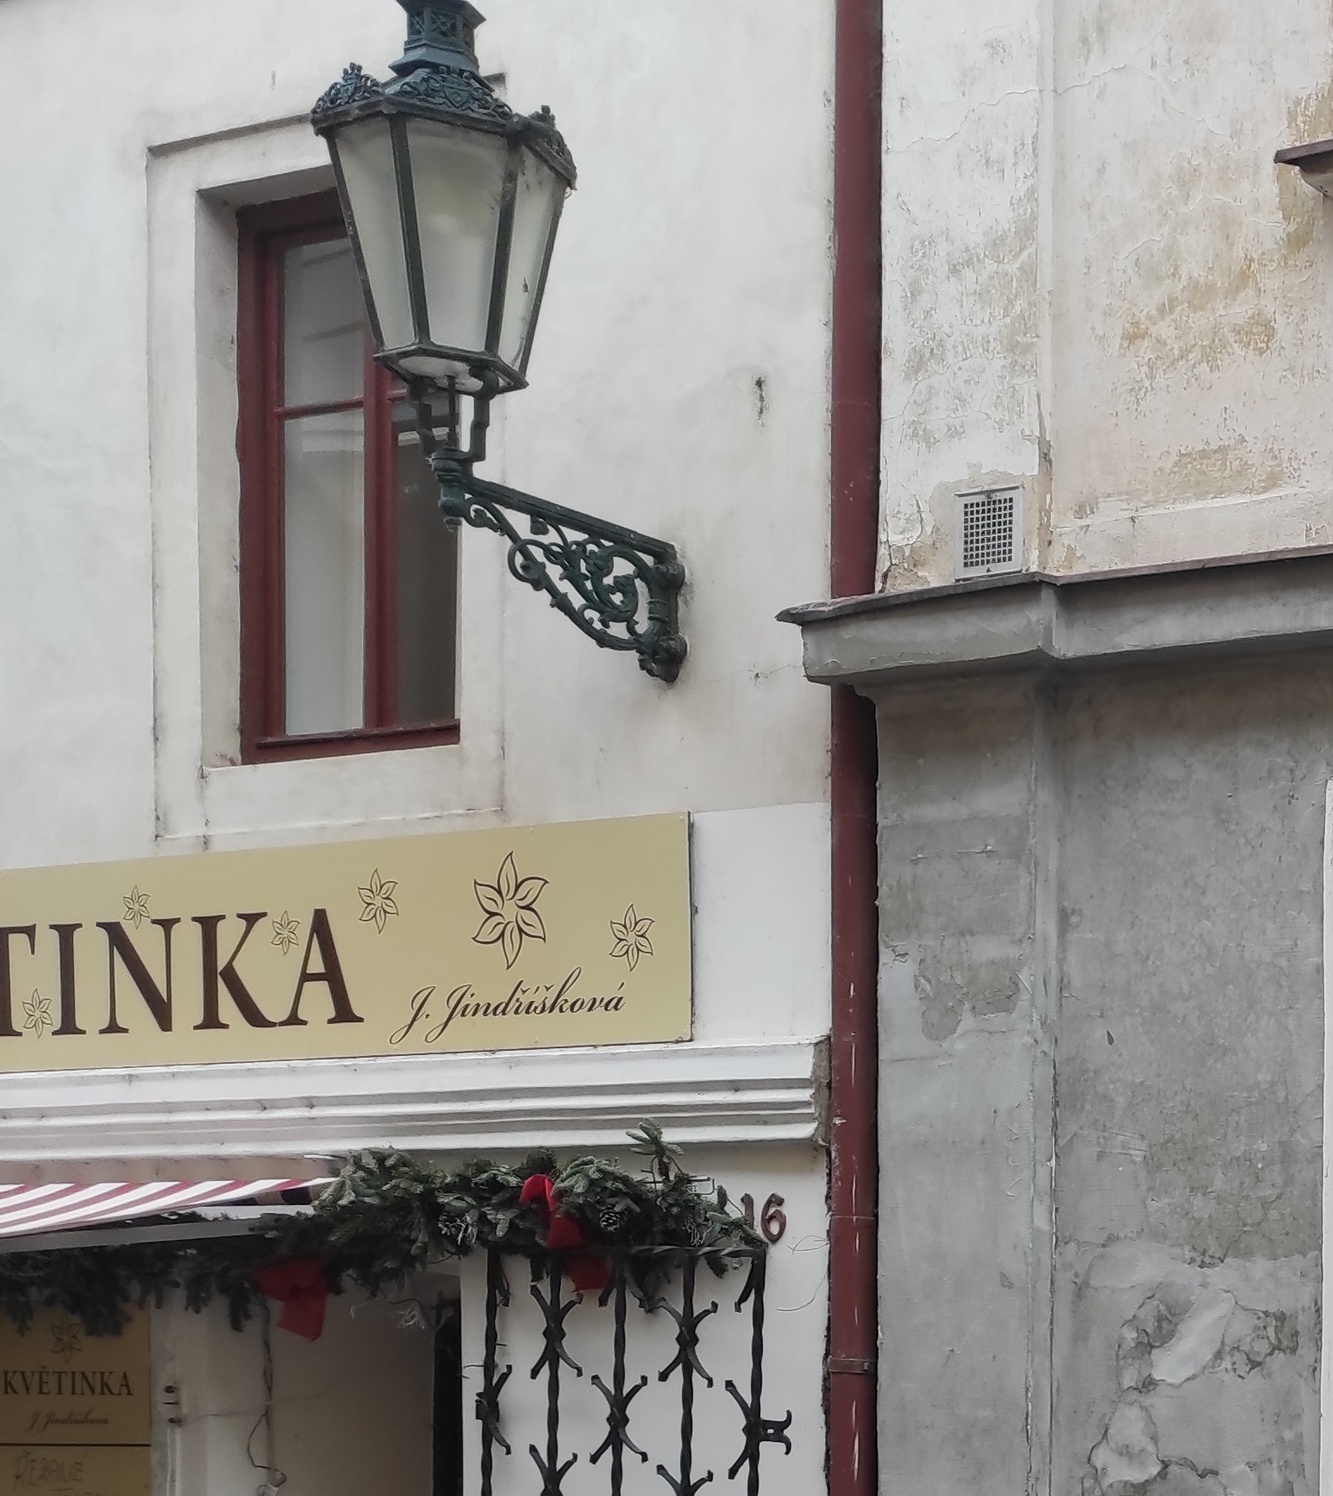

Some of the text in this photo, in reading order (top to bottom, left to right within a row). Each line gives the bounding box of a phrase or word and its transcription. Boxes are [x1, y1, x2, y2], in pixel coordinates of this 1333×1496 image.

[389, 966, 627, 1045] J. Jindříšková
[740, 1193, 787, 1243] 16
[2, 1365, 134, 1396] KVĚTINKA
